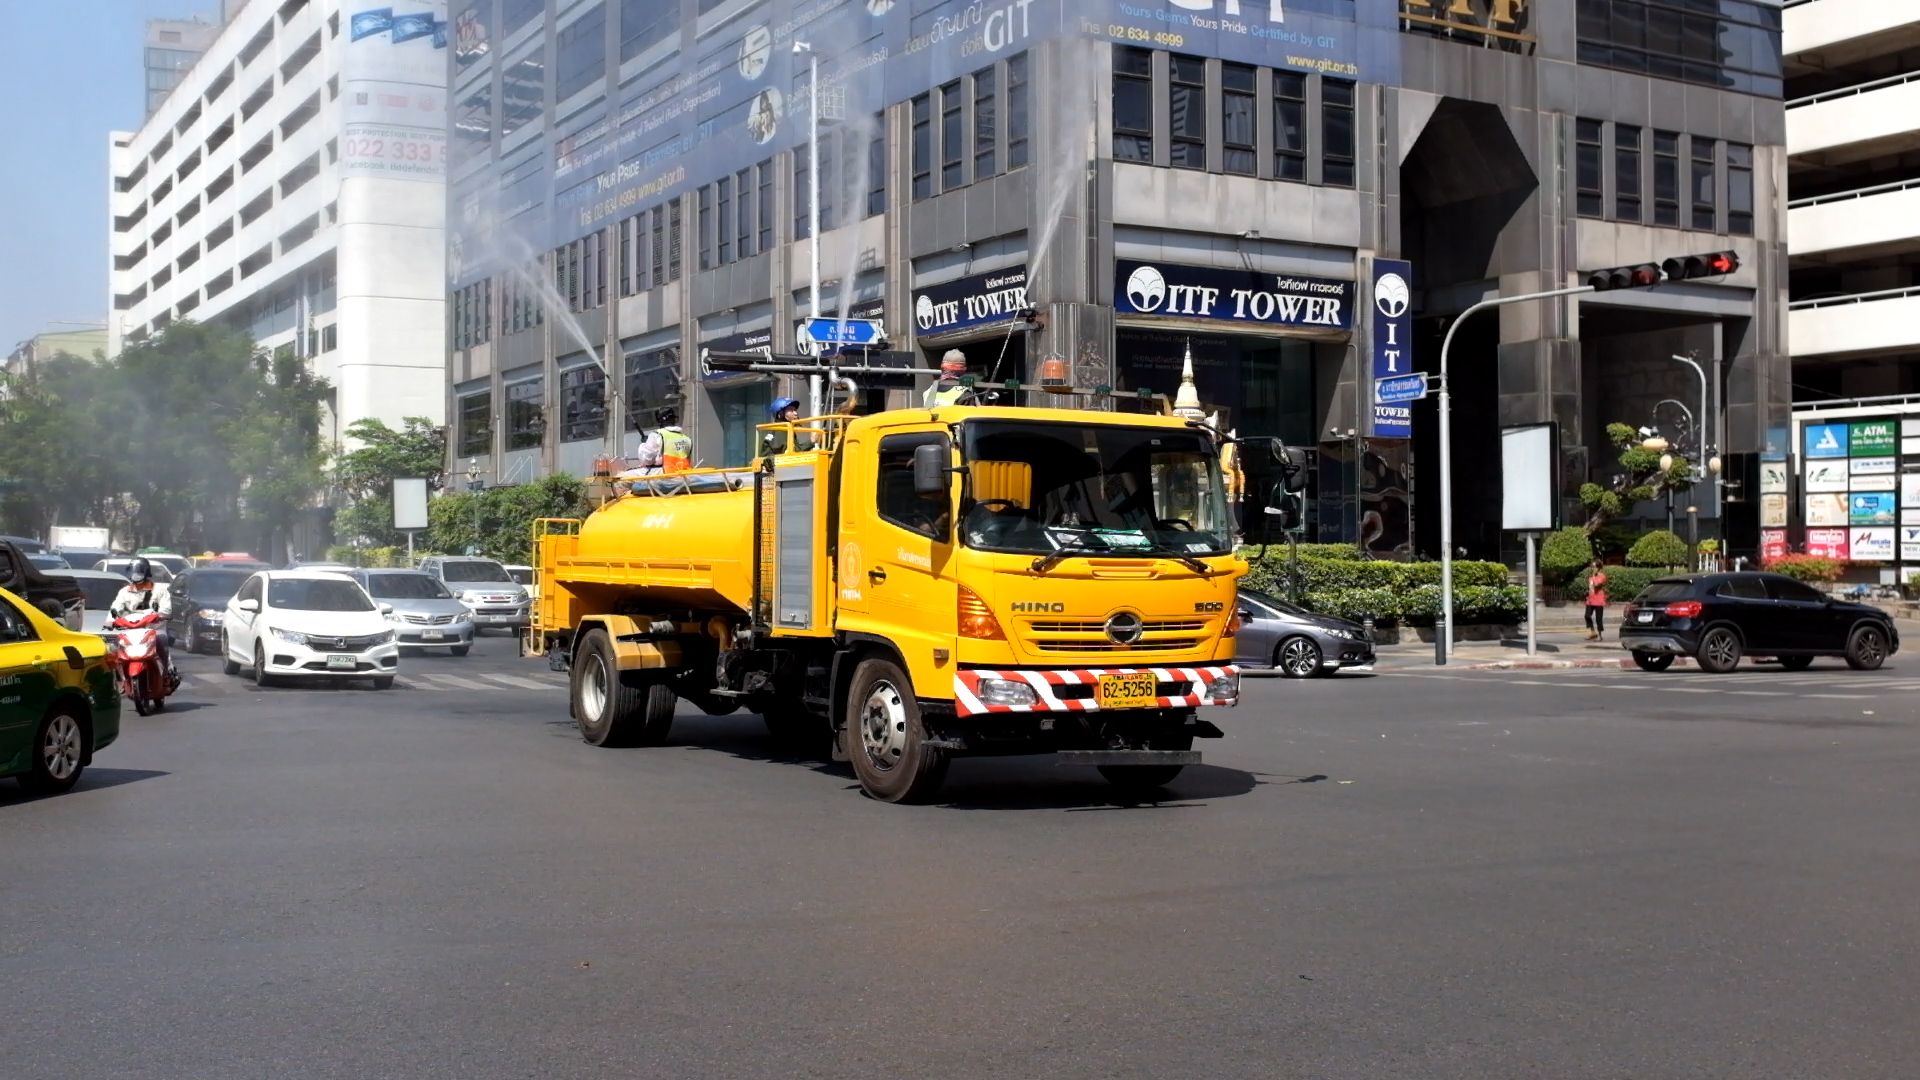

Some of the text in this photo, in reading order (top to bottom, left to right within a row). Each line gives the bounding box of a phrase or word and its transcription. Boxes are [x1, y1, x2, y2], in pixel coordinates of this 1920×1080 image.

[984, 0, 1034, 52] GIT
[1108, 24, 1124, 38] 02
[1127, 26, 1150, 42] 634
[1154, 32, 1184, 47] 4999
[1119, 3, 1150, 19] Yours
[1156, 9, 1188, 24] Gems
[1190, 14, 1218, 30] Yours
[1221, 20, 1247, 35] Pride
[1250, 25, 1297, 43] Certified
[1300, 33, 1314, 48] by
[1317, 36, 1336, 49] GIT
[1286, 55, 1358, 75] www.git.or.th
[347, 139, 385, 159] 022
[391, 141, 432, 163] 333
[935, 287, 1027, 326] ITF TOWER
[1165, 285, 1342, 326] ITF TOWER
[1375, 405, 1410, 417] TOWER
[1863, 425, 1887, 436] ATM
[1011, 602, 1064, 613] HINO
[1194, 602, 1223, 612] 500
[1103, 681, 1153, 698] 62-5256
